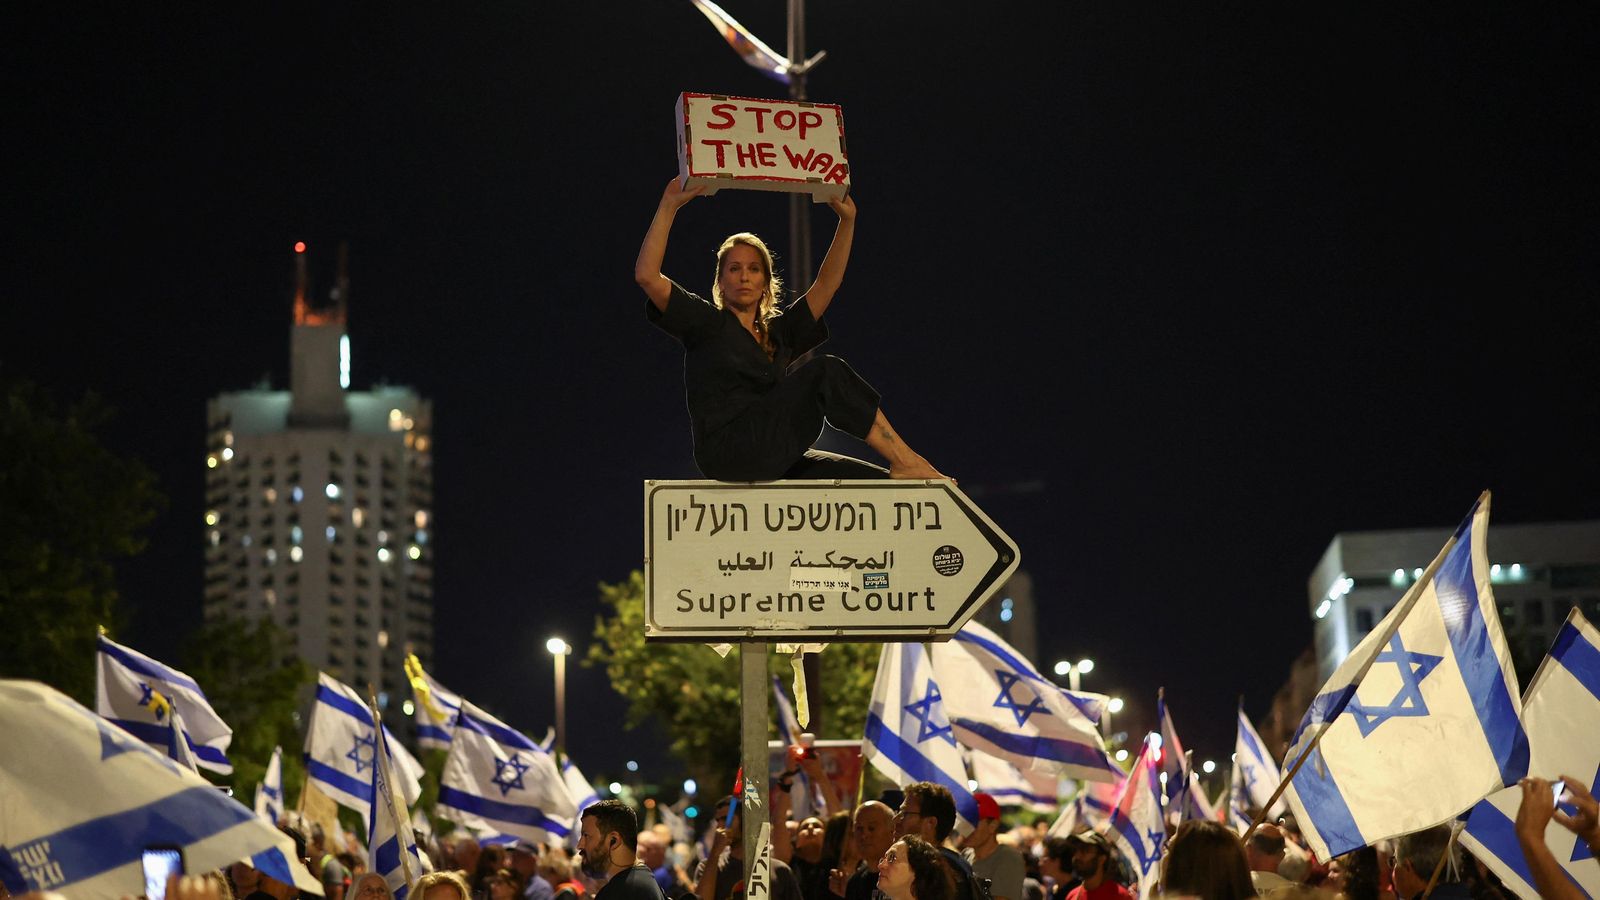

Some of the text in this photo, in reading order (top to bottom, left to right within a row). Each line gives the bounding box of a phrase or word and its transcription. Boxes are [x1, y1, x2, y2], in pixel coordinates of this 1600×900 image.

[706, 103, 823, 140] STOP
[701, 139, 848, 185] THE WAR
[667, 494, 942, 541] בית המשפט העליון
[789, 550, 894, 570] المحكمة
[676, 586, 935, 619] Supreme Court
